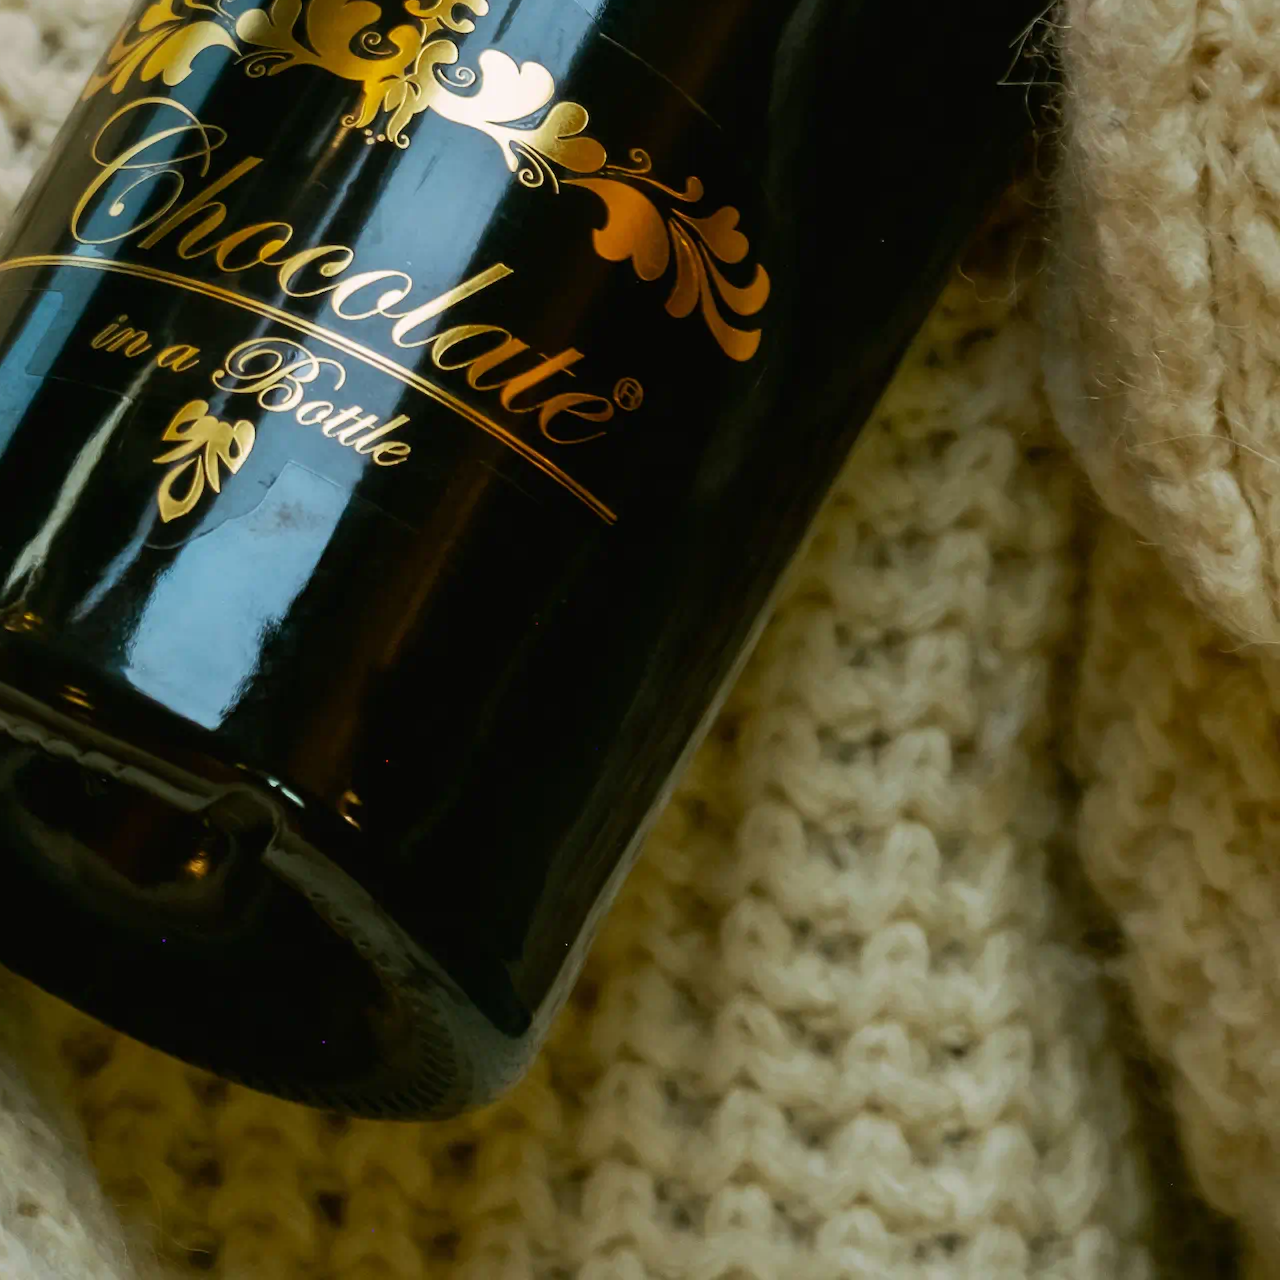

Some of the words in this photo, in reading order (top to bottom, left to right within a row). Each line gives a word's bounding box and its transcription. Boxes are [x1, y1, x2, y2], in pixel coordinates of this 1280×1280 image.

[91, 314, 152, 358] in
[157, 344, 200, 372] a
[212, 337, 411, 467] Bottle
